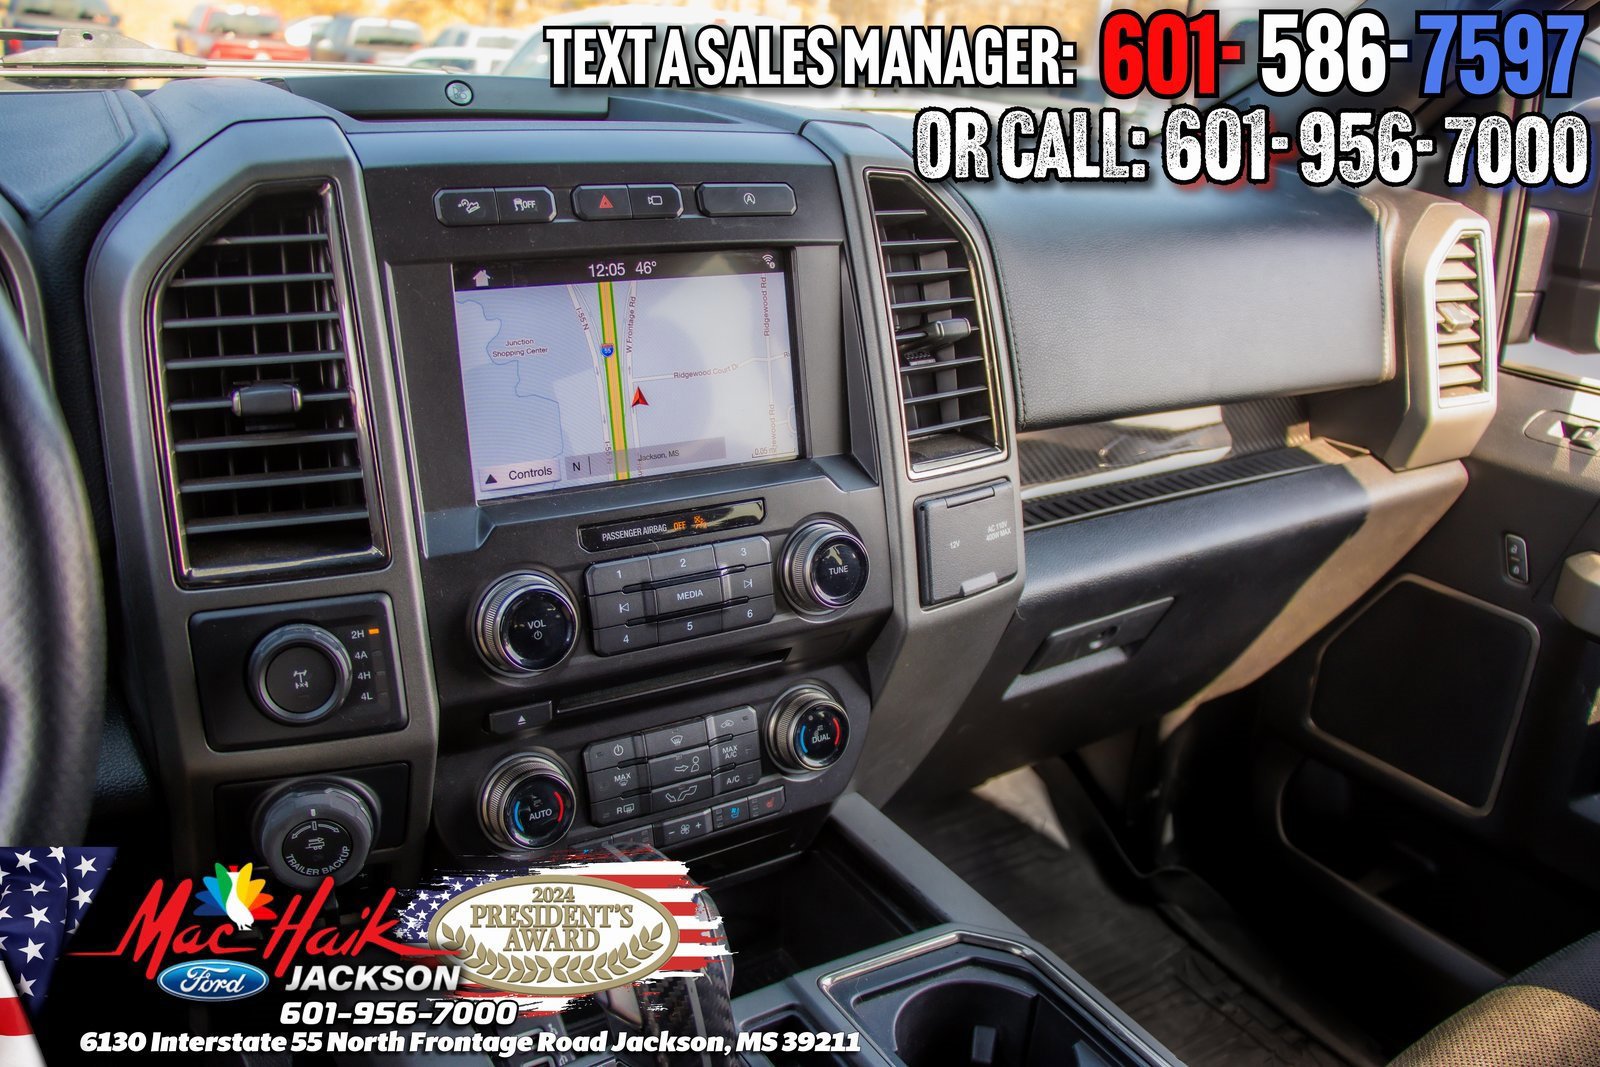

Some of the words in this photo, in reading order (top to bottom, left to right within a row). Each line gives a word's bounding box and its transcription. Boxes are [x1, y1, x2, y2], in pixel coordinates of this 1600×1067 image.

[522, 200, 536, 209] OFF
[588, 263, 626, 278] 12:05
[635, 261, 657, 275] 46°
[760, 276, 767, 288] Rd
[629, 296, 636, 307] Rd
[761, 290, 771, 336] Ridgewood
[627, 310, 636, 344] Frontage
[505, 338, 535, 347] Junction
[493, 349, 524, 359] Shopping
[526, 347, 548, 356] Center
[673, 368, 712, 380] Ridgewood
[713, 366, 731, 375] Court
[638, 452, 667, 462] Jackson,
[668, 449, 680, 458] MS
[508, 466, 553, 481] Controls
[572, 462, 581, 472] N
[602, 527, 642, 542] PASSENGER
[642, 523, 668, 535] AIRBAG
[673, 520, 686, 530] OFF
[987, 525, 996, 533] AC
[1000, 527, 1011, 536] MAX
[950, 540, 960, 549] 12V
[740, 547, 747, 557] 3
[679, 558, 687, 568] 2
[616, 569, 622, 579] 1
[828, 565, 849, 575] TUNE
[676, 589, 704, 601] MEDIA
[747, 609, 753, 618] 6
[527, 619, 546, 629] VOL
[687, 621, 693, 631] 5
[351, 630, 365, 639] 2H
[623, 634, 630, 643] 4
[354, 651, 368, 659] 4A
[357, 671, 371, 680] 4H
[360, 692, 373, 701] 4L
[811, 733, 831, 744] DUAL
[722, 745, 738, 753] MAX
[614, 772, 632, 781] MAX
[726, 775, 740, 784] A/C
[529, 808, 553, 821] AUTO
[285, 853, 320, 876] TRAILER
[321, 845, 351, 875] BACKUP
